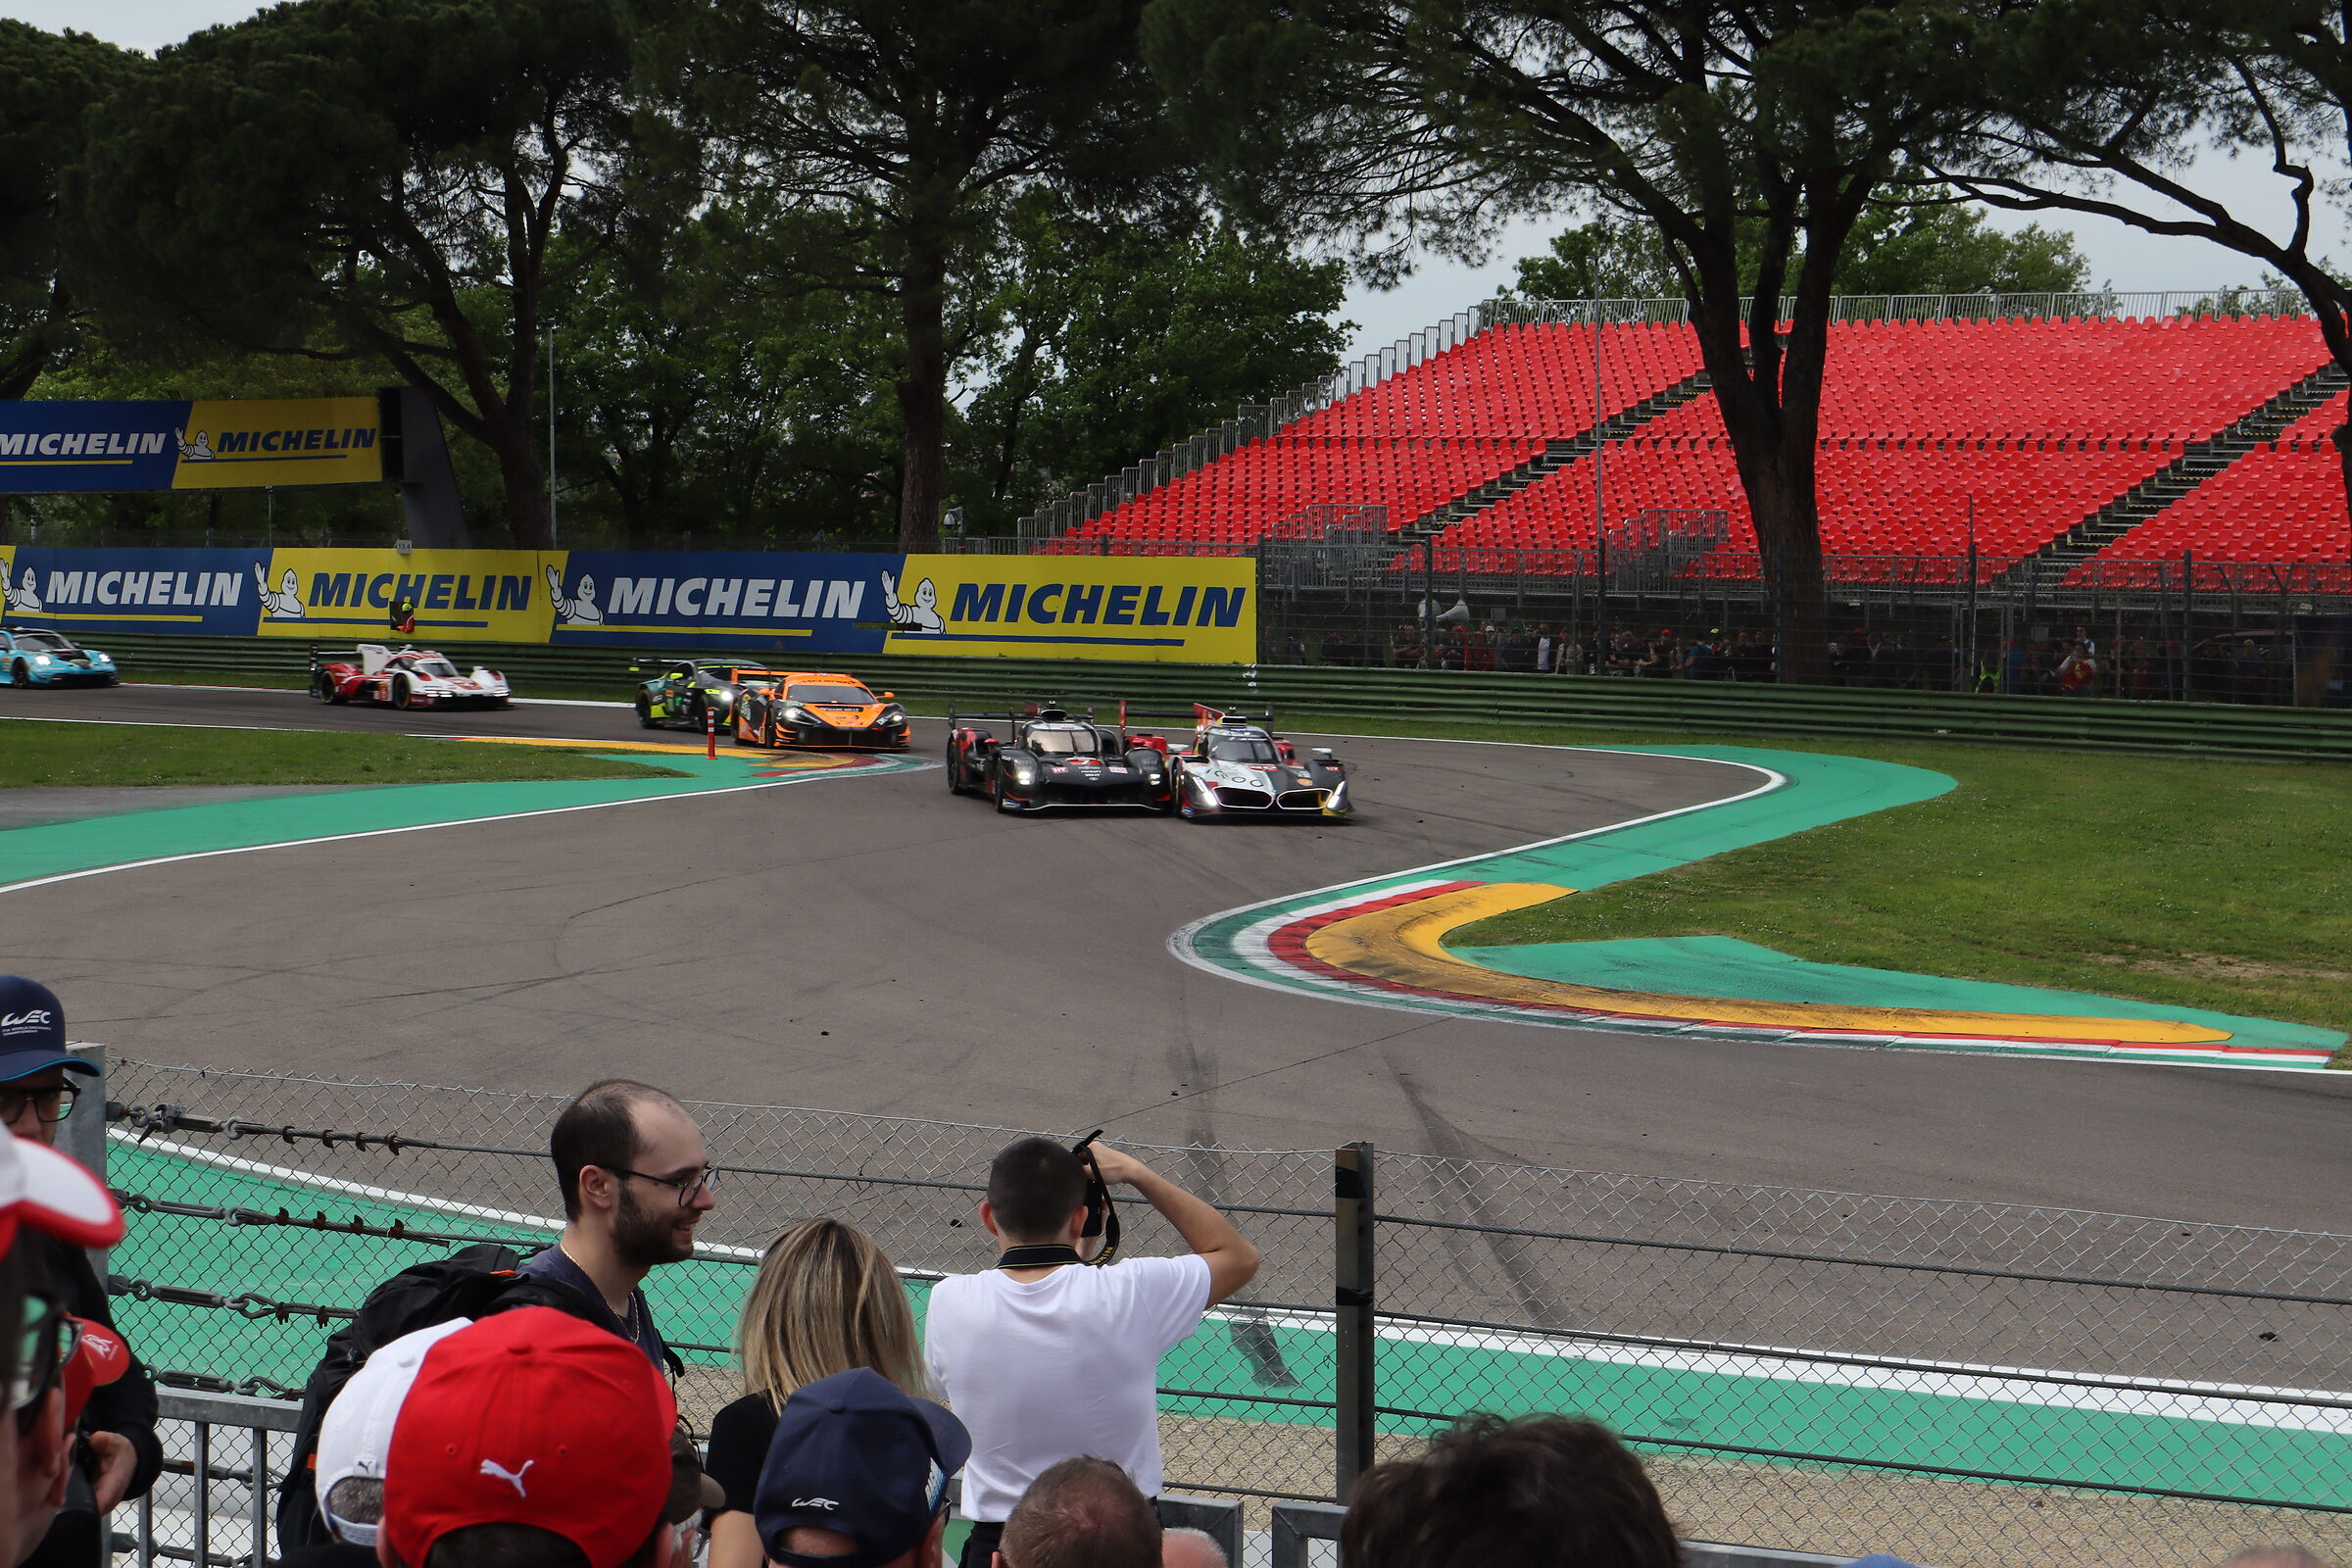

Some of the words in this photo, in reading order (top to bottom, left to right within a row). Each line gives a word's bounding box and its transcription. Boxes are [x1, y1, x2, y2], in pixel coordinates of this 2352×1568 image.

[0, 433, 167, 455] MICHELIN
[218, 428, 376, 453] MICHELIN
[45, 570, 243, 607] MICHELIN
[309, 572, 532, 611] MICHELIN
[608, 576, 866, 619] MICHELIN
[950, 583, 1246, 628] MICHELIN
[1, 1009, 51, 1026] WEC
[792, 1497, 839, 1510] WEC
